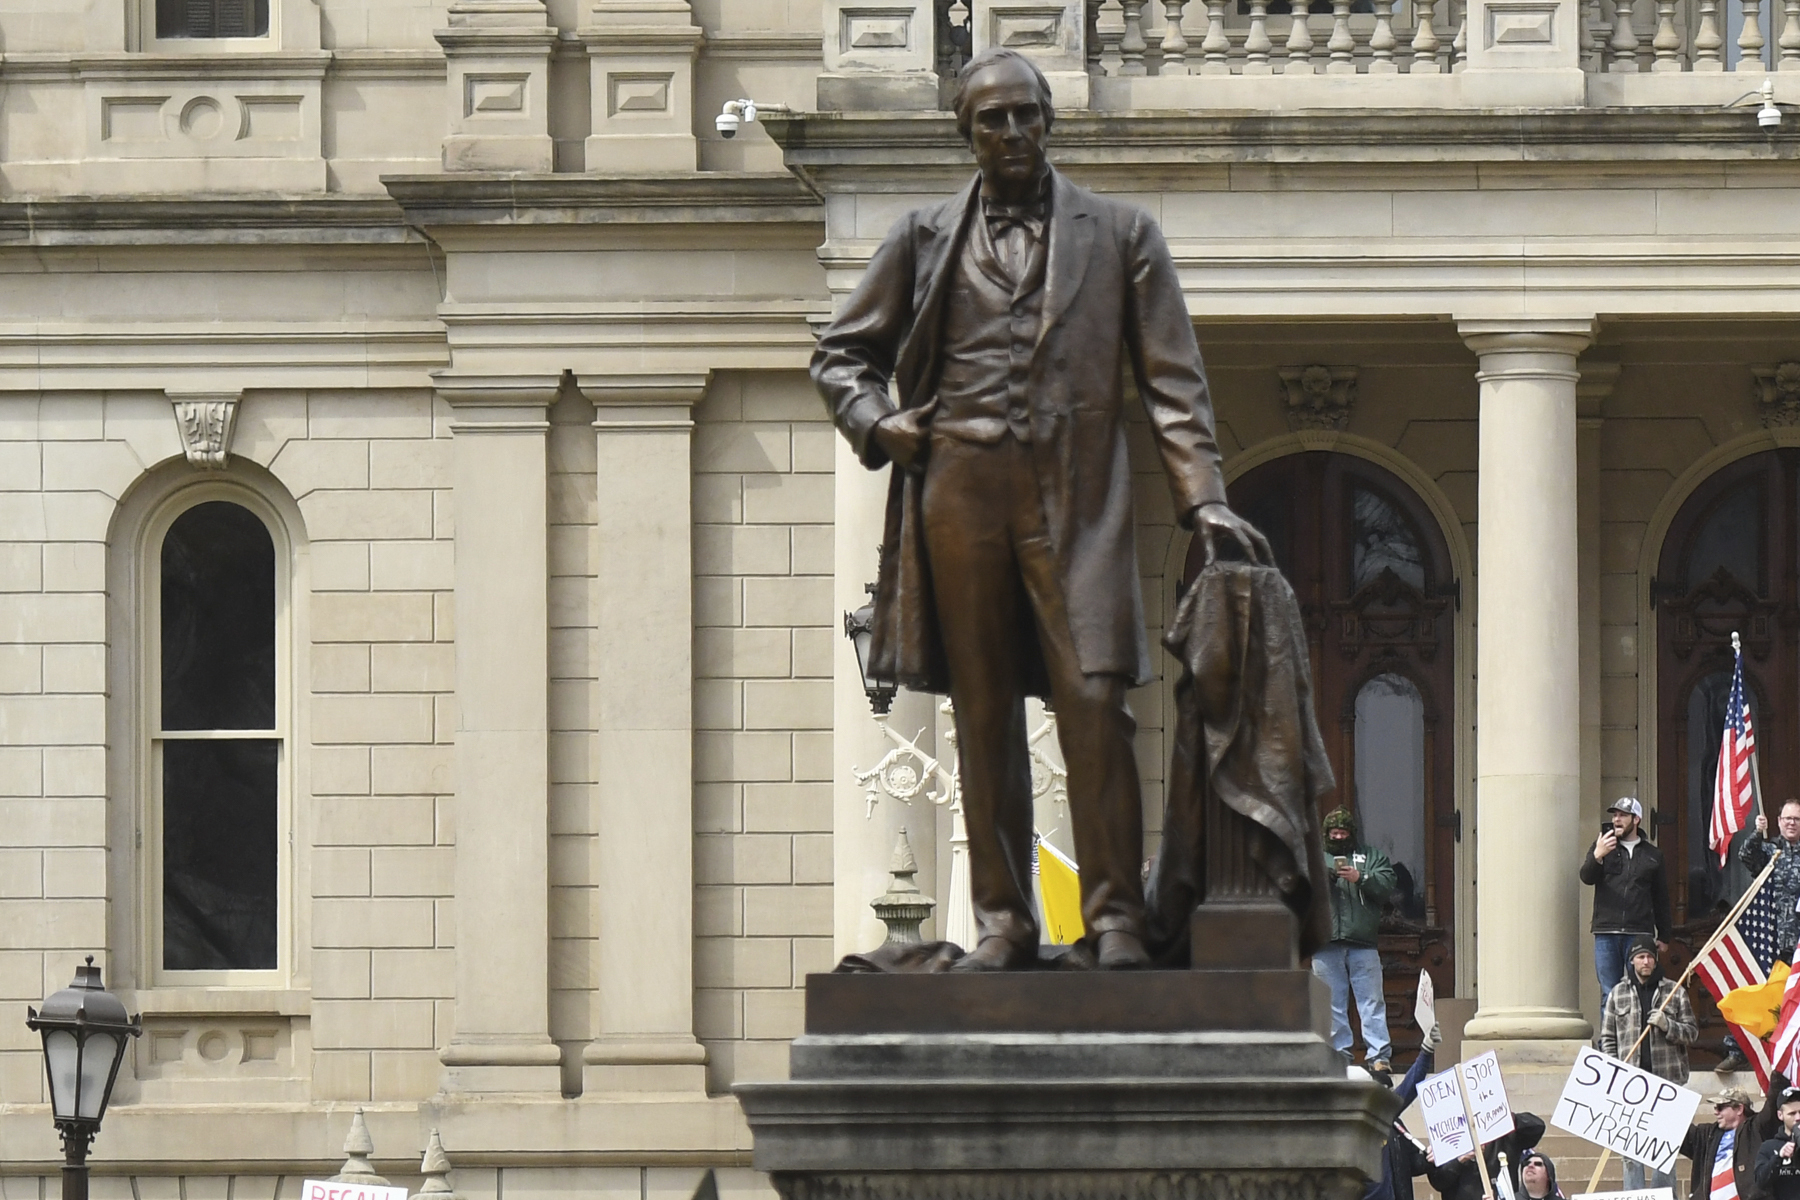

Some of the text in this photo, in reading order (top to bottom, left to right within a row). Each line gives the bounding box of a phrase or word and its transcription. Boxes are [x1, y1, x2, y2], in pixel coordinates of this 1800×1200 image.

[1466, 1058, 1495, 1091] STOP
[1575, 1054, 1677, 1113] STOP
[1422, 1080, 1456, 1108] OPEN
[1478, 1089, 1494, 1102] the
[1606, 1098, 1654, 1132] THE
[1564, 1097, 1681, 1170] TYRANNY
